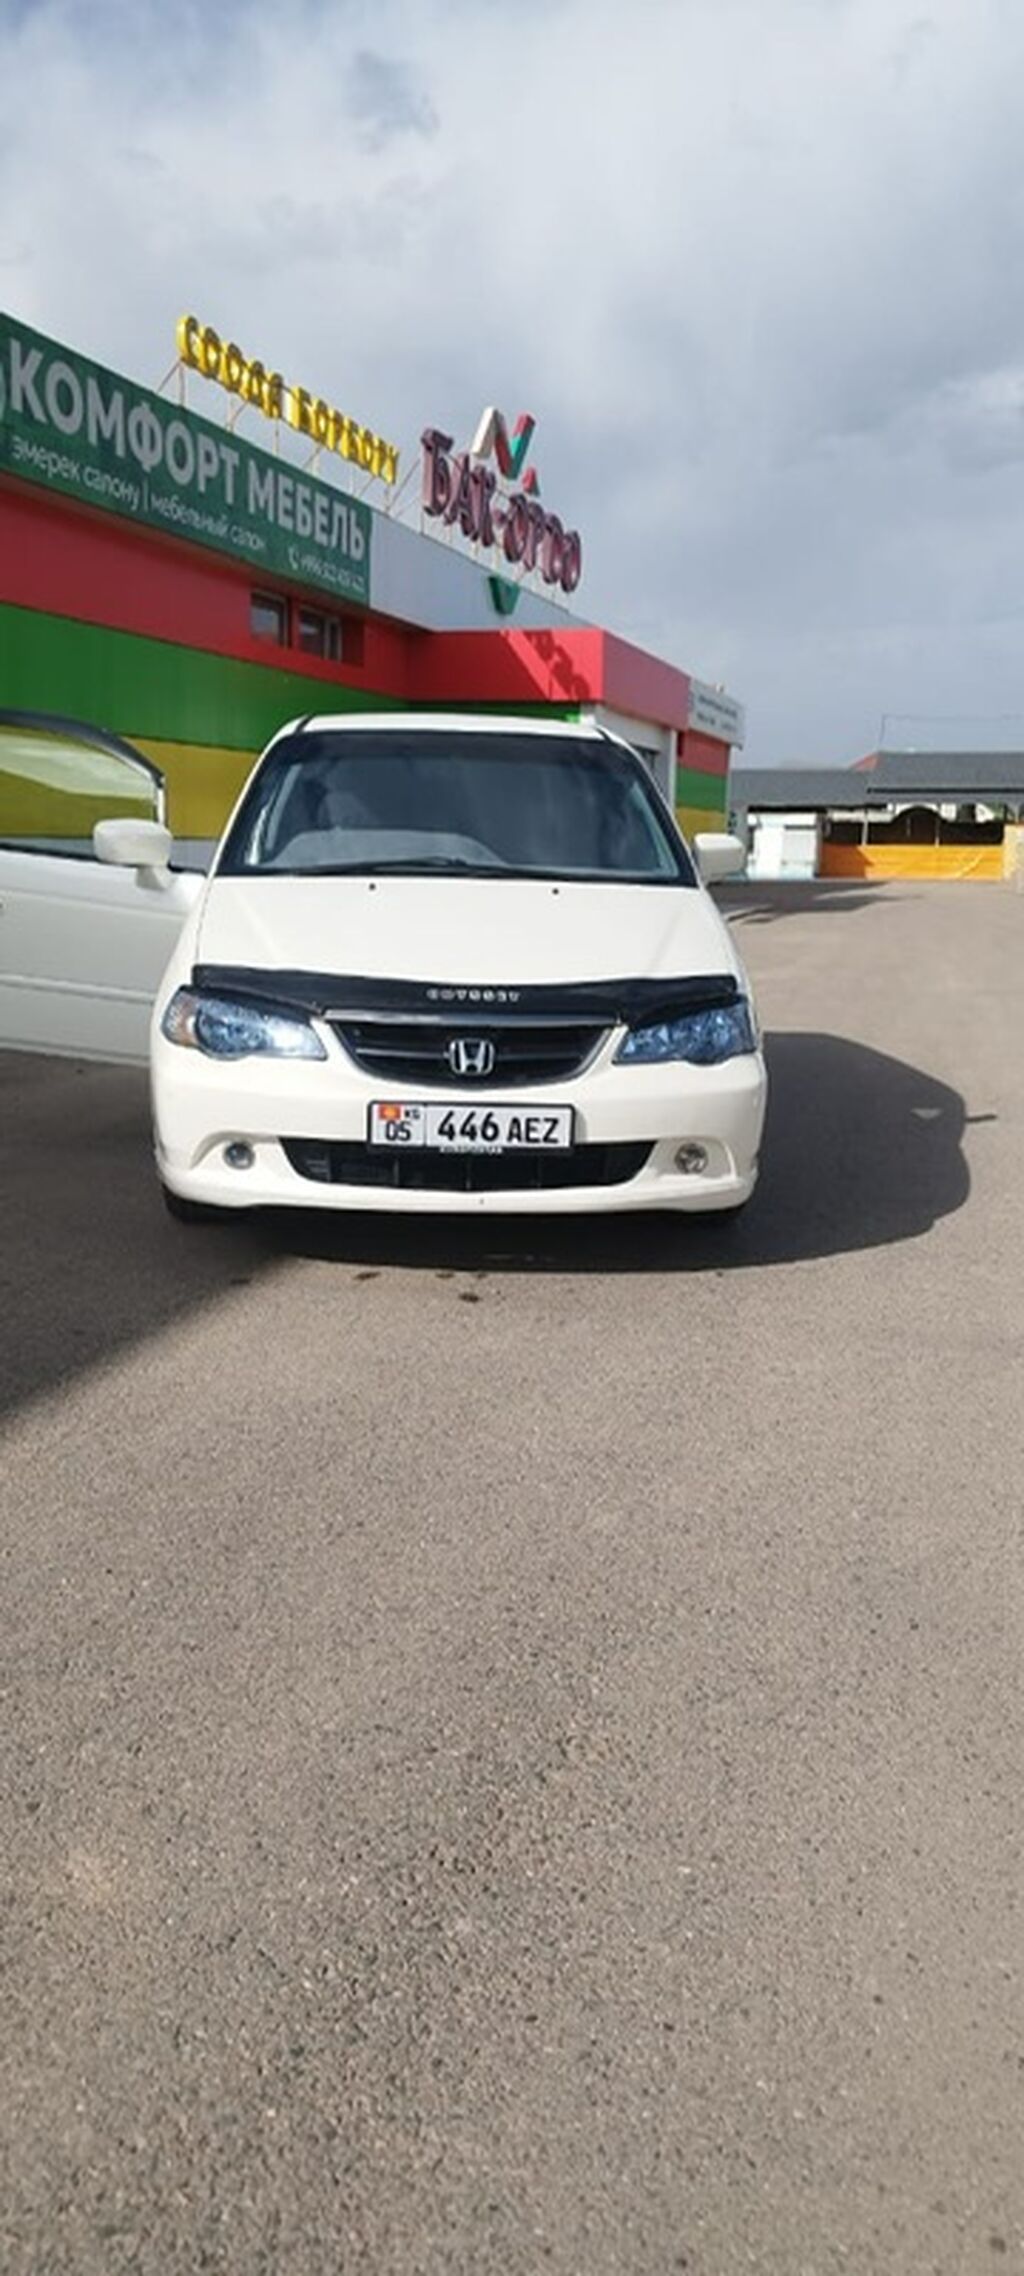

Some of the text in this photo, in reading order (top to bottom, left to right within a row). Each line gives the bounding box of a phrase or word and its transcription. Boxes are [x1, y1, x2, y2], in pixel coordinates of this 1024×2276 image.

[10, 338, 366, 561] КОМФОРТ МЕБЕЛЬ
[83, 466, 140, 511] салону
[385, 1111, 559, 1144] 05 446 AEZ
